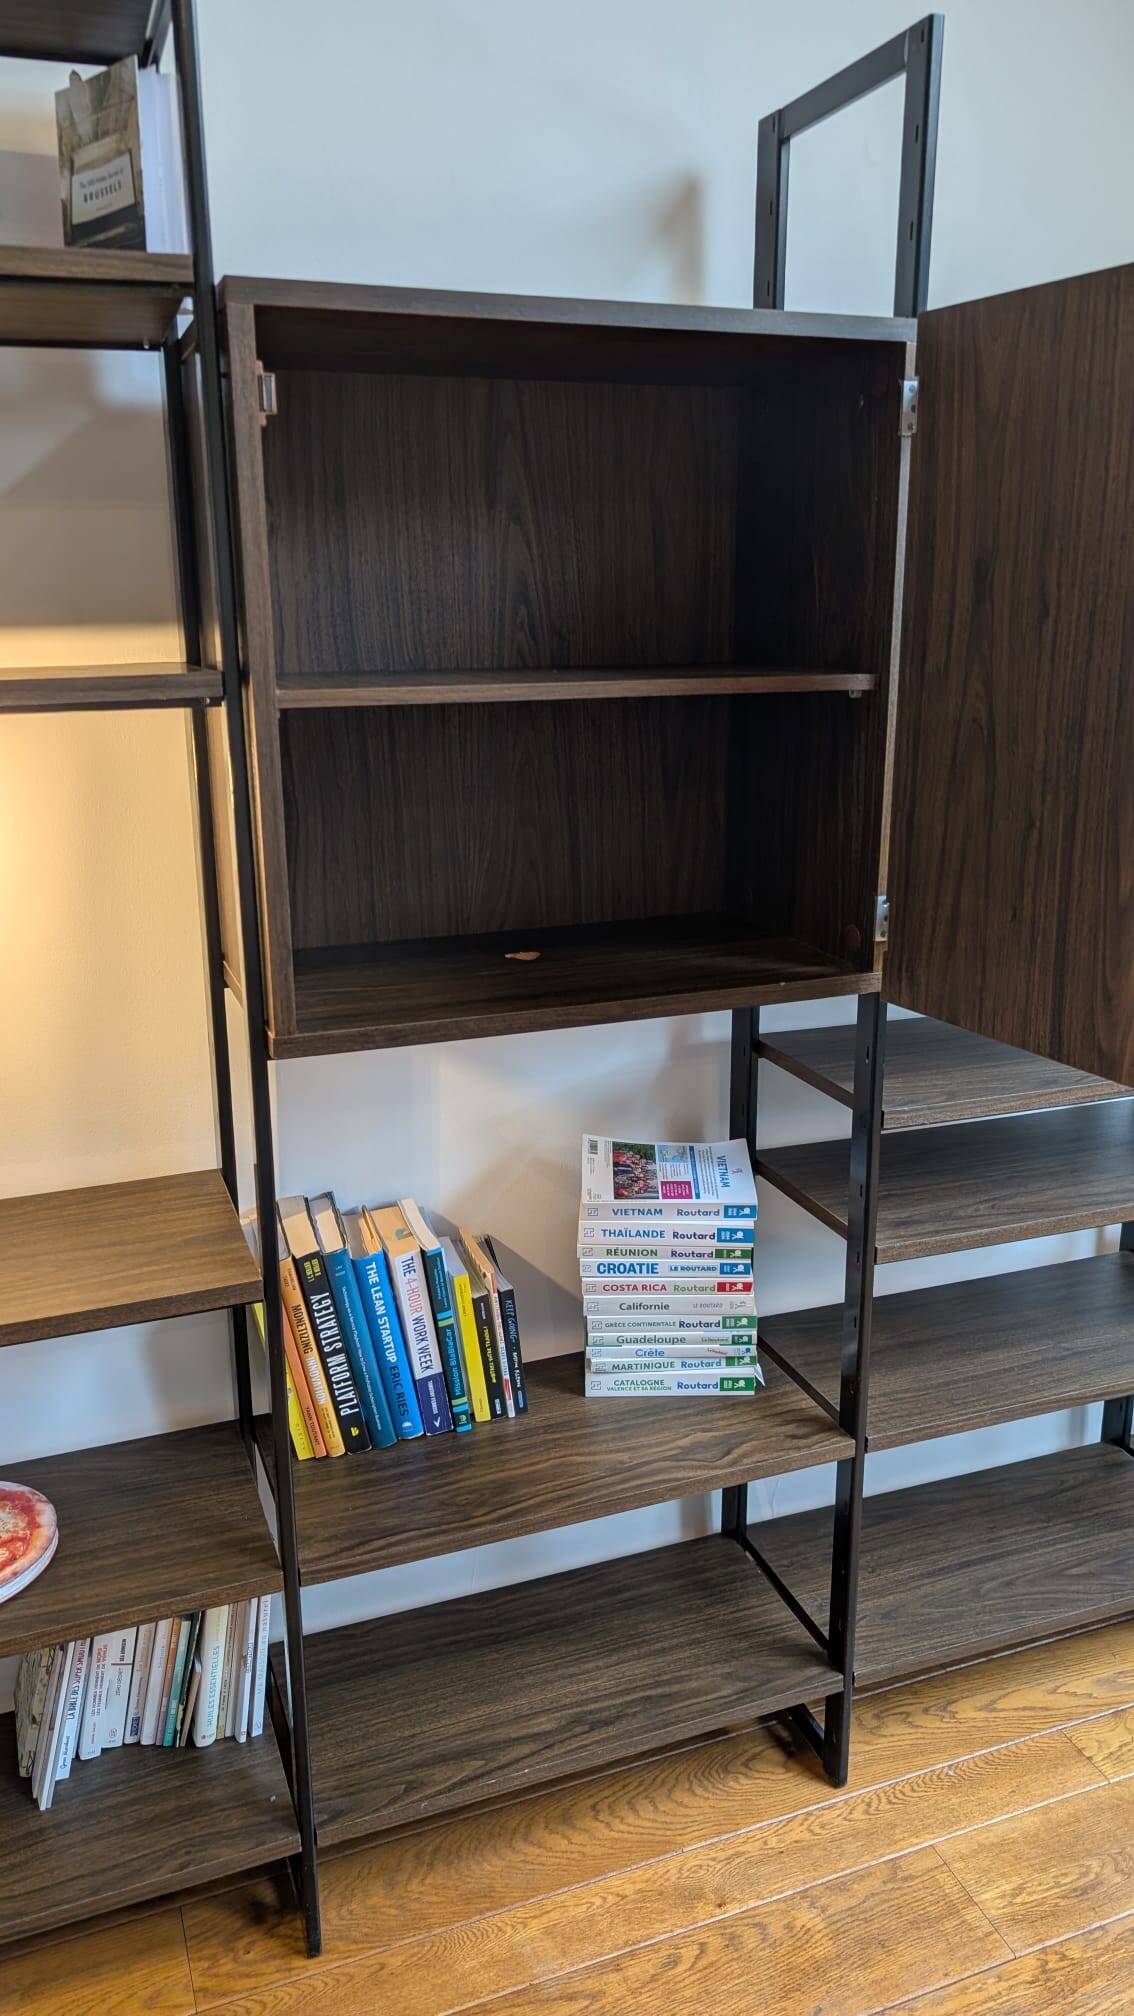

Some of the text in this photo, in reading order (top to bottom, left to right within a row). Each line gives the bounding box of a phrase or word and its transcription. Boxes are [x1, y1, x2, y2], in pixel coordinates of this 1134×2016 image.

[83, 181, 122, 203] BRUSSELS
[716, 1155, 731, 1188] VIETNAM
[677, 1209, 720, 1217] Routard
[601, 1228, 715, 1240] THAÏLANDE Routard
[606, 1247, 713, 1258] RÉUNION Routard
[597, 1263, 659, 1274] CROATIE
[401, 1256, 433, 1373] THE 4-HOUR WORK WEEK
[505, 1299, 515, 1316] KEEP
[619, 1302, 670, 1310] Californie
[310, 1291, 342, 1353] STRATEGY
[366, 1262, 410, 1417] THE LEAN STARTUP ERIC RIES
[617, 1335, 686, 1345] Guadeloupe
[291, 1304, 314, 1354] MONETIZING
[306, 1355, 327, 1405] INNOVATION
[444, 1328, 462, 1395] Mission BlaBlaCar
[612, 1360, 722, 1371] MARTINIQUE Routard
[326, 1352, 359, 1416] PLATFORM
[677, 1382, 718, 1390] Routard
[262, 1599, 270, 1633] naturel
[73, 1666, 82, 1685] SUPER
[208, 1647, 220, 1698] ESSENTIELLES
[71, 1685, 80, 1696] DES
[68, 1696, 78, 1711] BIBLE
[67, 1711, 76, 1720] LA
[207, 1699, 215, 1727] HUILES
